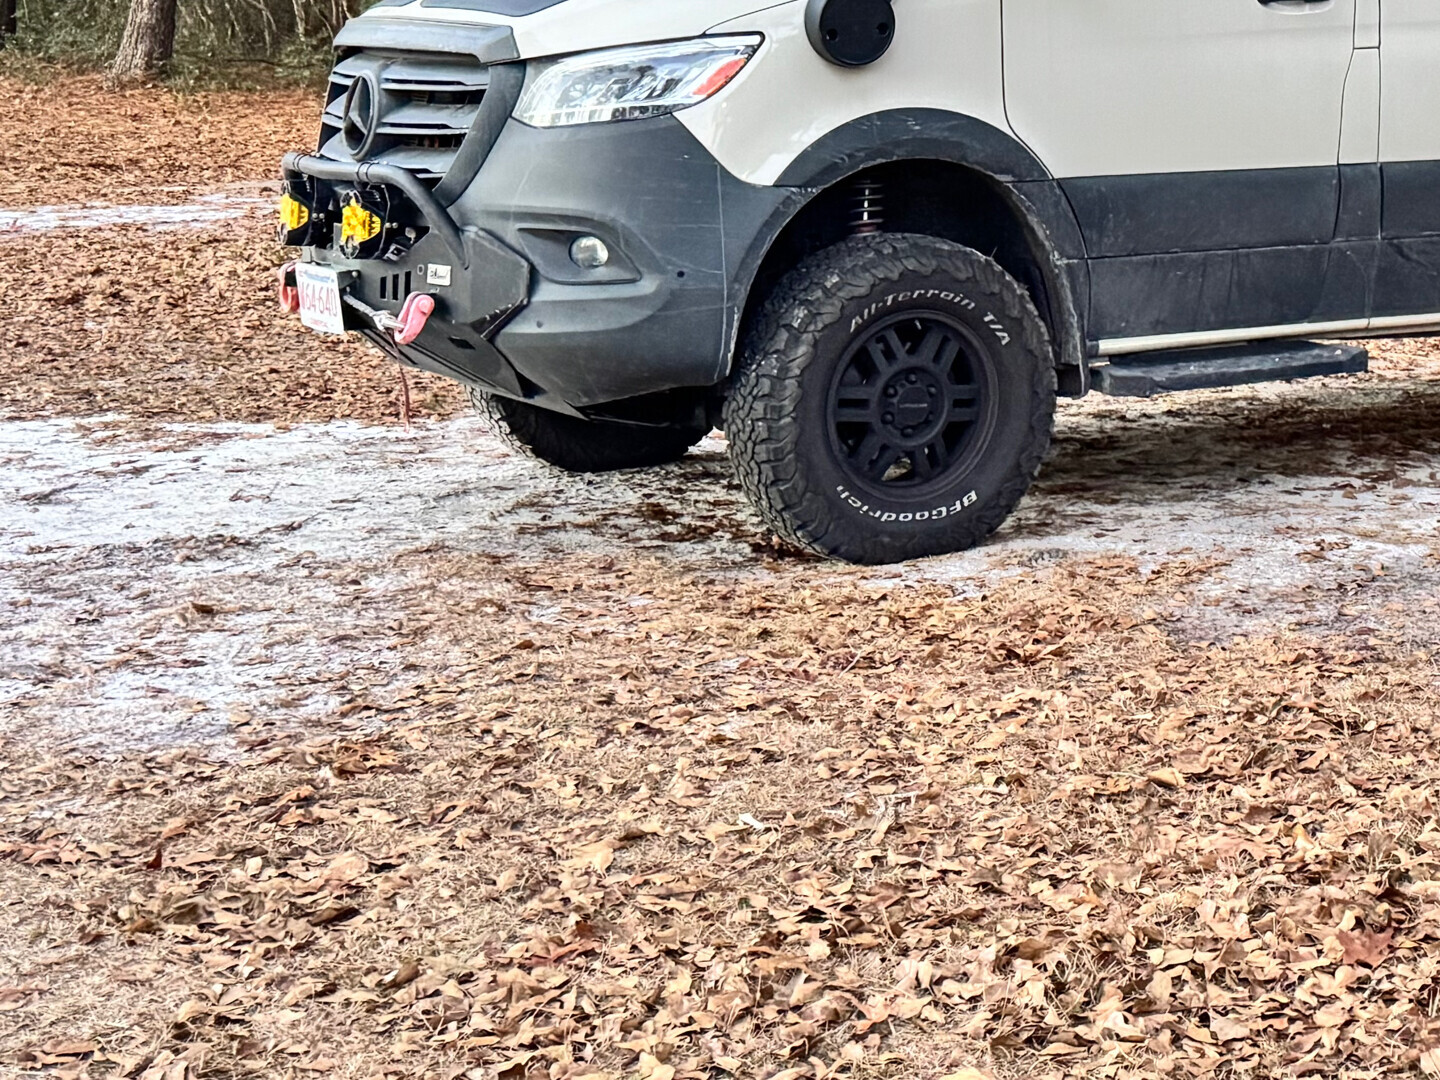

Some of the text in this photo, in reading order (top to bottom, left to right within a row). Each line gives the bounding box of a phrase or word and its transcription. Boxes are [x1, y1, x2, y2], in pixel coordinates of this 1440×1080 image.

[849, 289, 1010, 346] All-Terrain T/A
[836, 485, 978, 522] BFGoodrich
